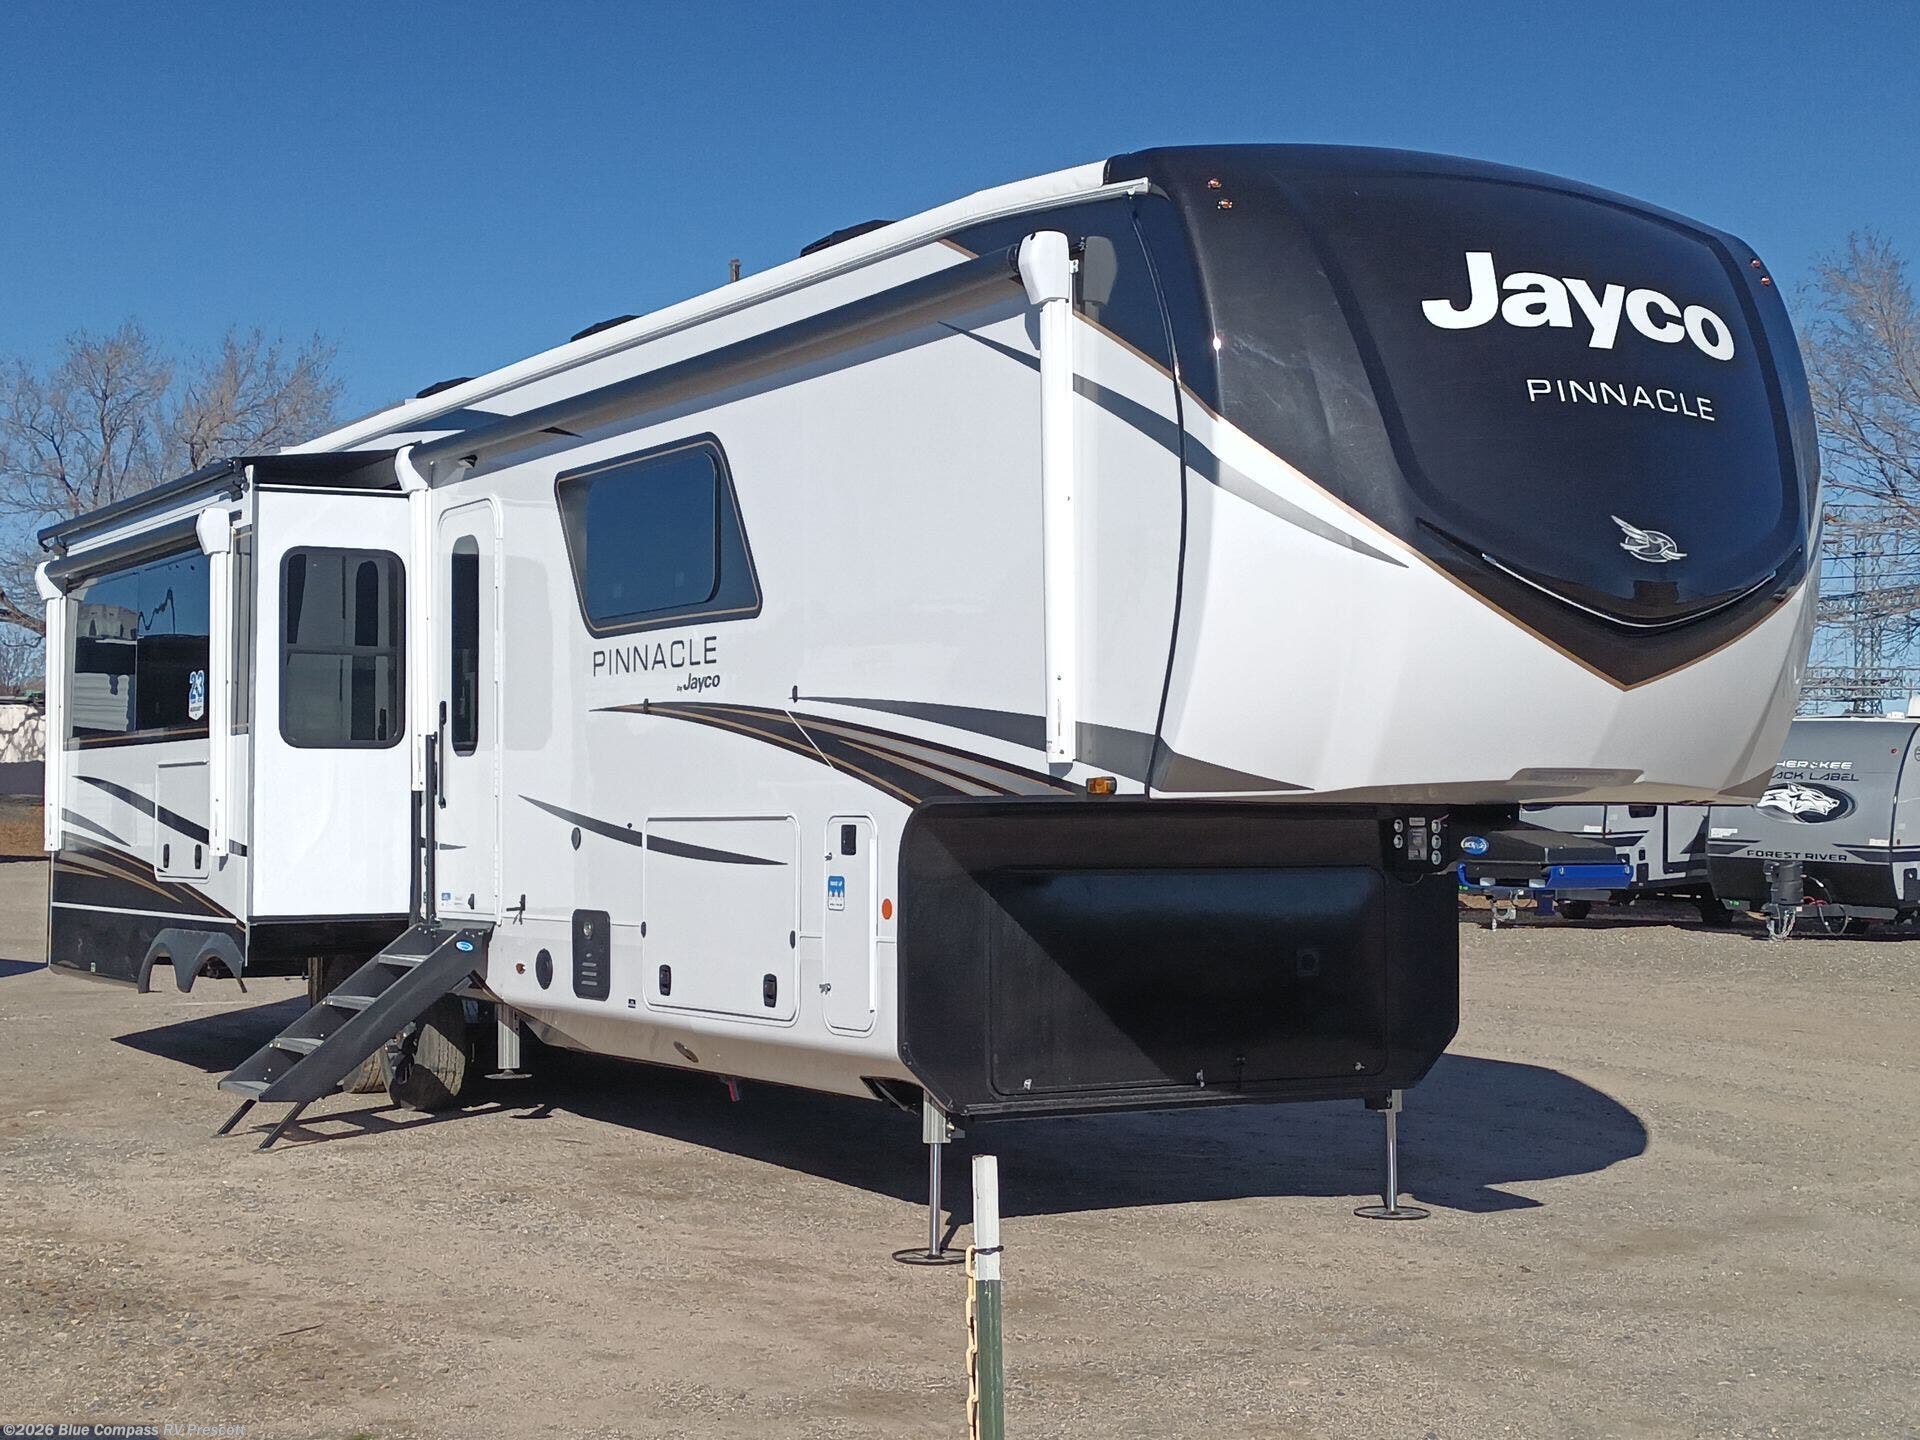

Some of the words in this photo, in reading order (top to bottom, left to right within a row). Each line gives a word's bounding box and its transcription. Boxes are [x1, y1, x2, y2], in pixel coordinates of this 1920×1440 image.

[1421, 251, 1735, 361] Jayco
[1526, 379, 1715, 422] PINNACLE
[593, 636, 717, 677] PINNACLE
[683, 673, 720, 693] Jayco
[1776, 760, 1853, 770] HEROKEE
[1771, 771, 1804, 780] ACK
[1809, 773, 1860, 782] LABEL
[1746, 850, 1801, 859] FOREST
[1804, 852, 1848, 862] RIVER
